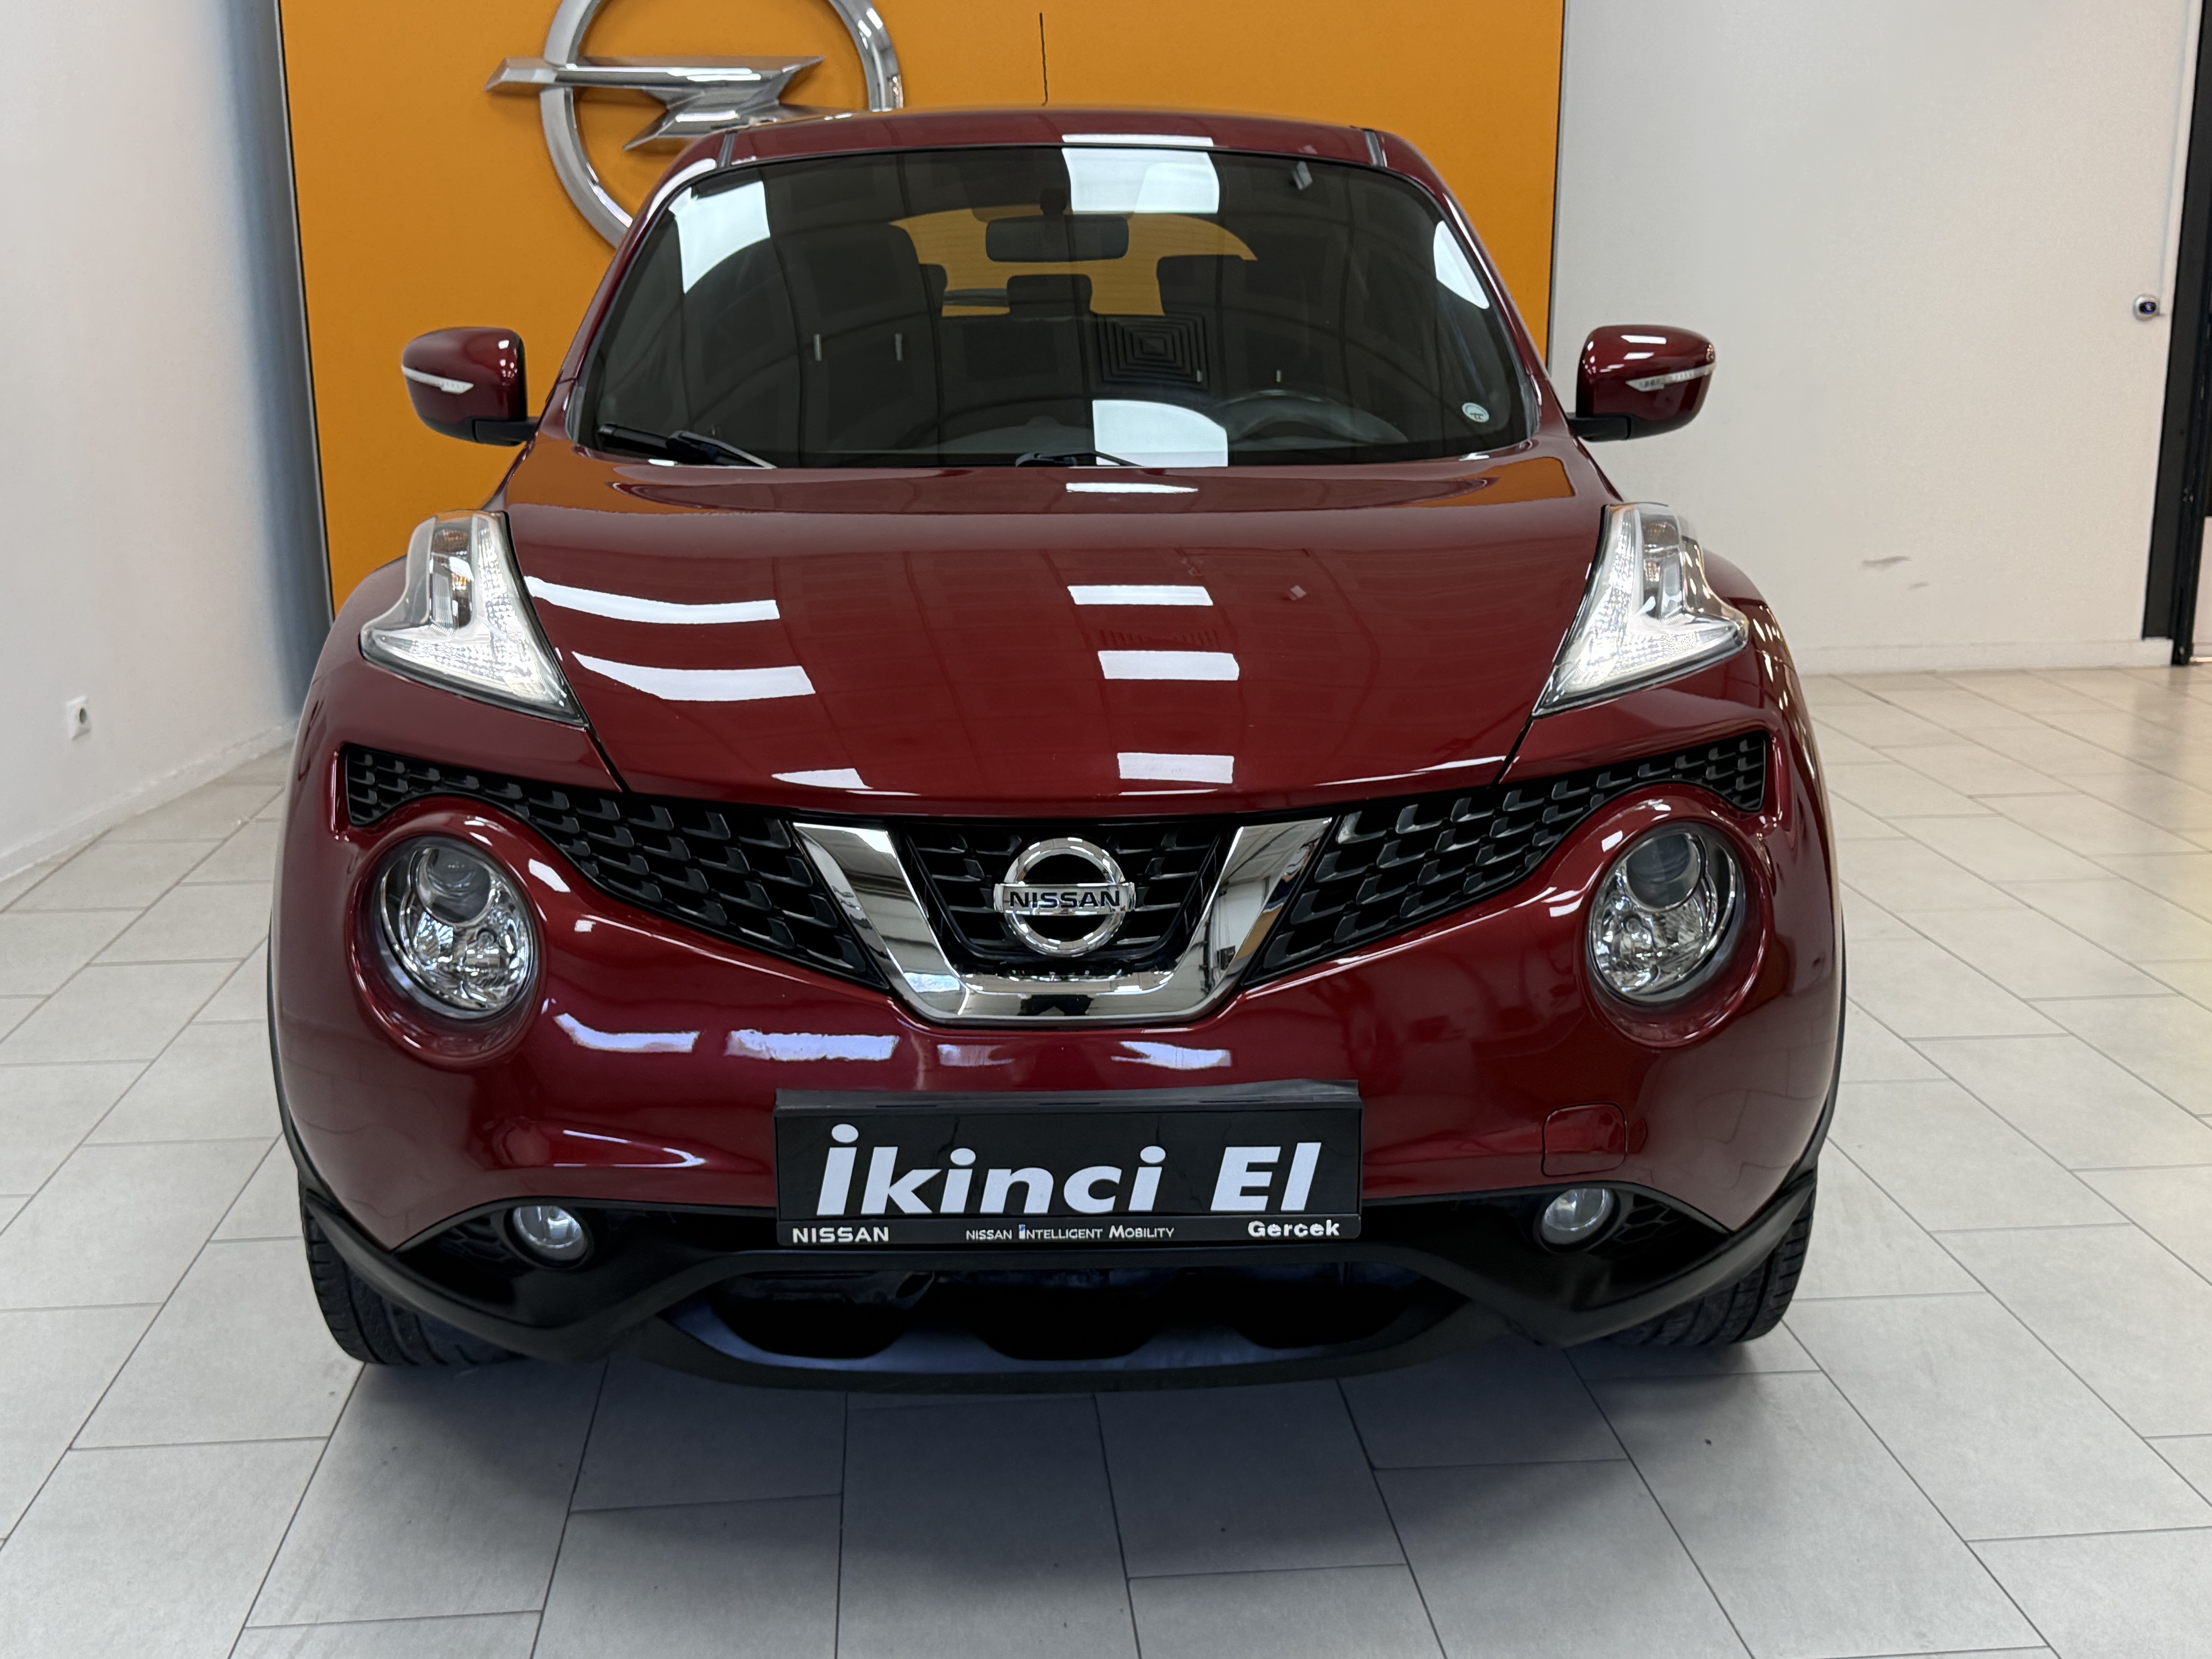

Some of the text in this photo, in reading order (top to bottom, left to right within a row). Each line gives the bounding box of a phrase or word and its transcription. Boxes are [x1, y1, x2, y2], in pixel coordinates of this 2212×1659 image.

[1010, 891, 1120, 908] NISSAN
[816, 1123, 1322, 1216] İkinci El
[792, 1226, 889, 1243] NISSAN
[966, 1229, 1012, 1240] NISSAN
[1109, 1224, 1175, 1239] MOBILITY
[1248, 1219, 1340, 1238] Gercek
